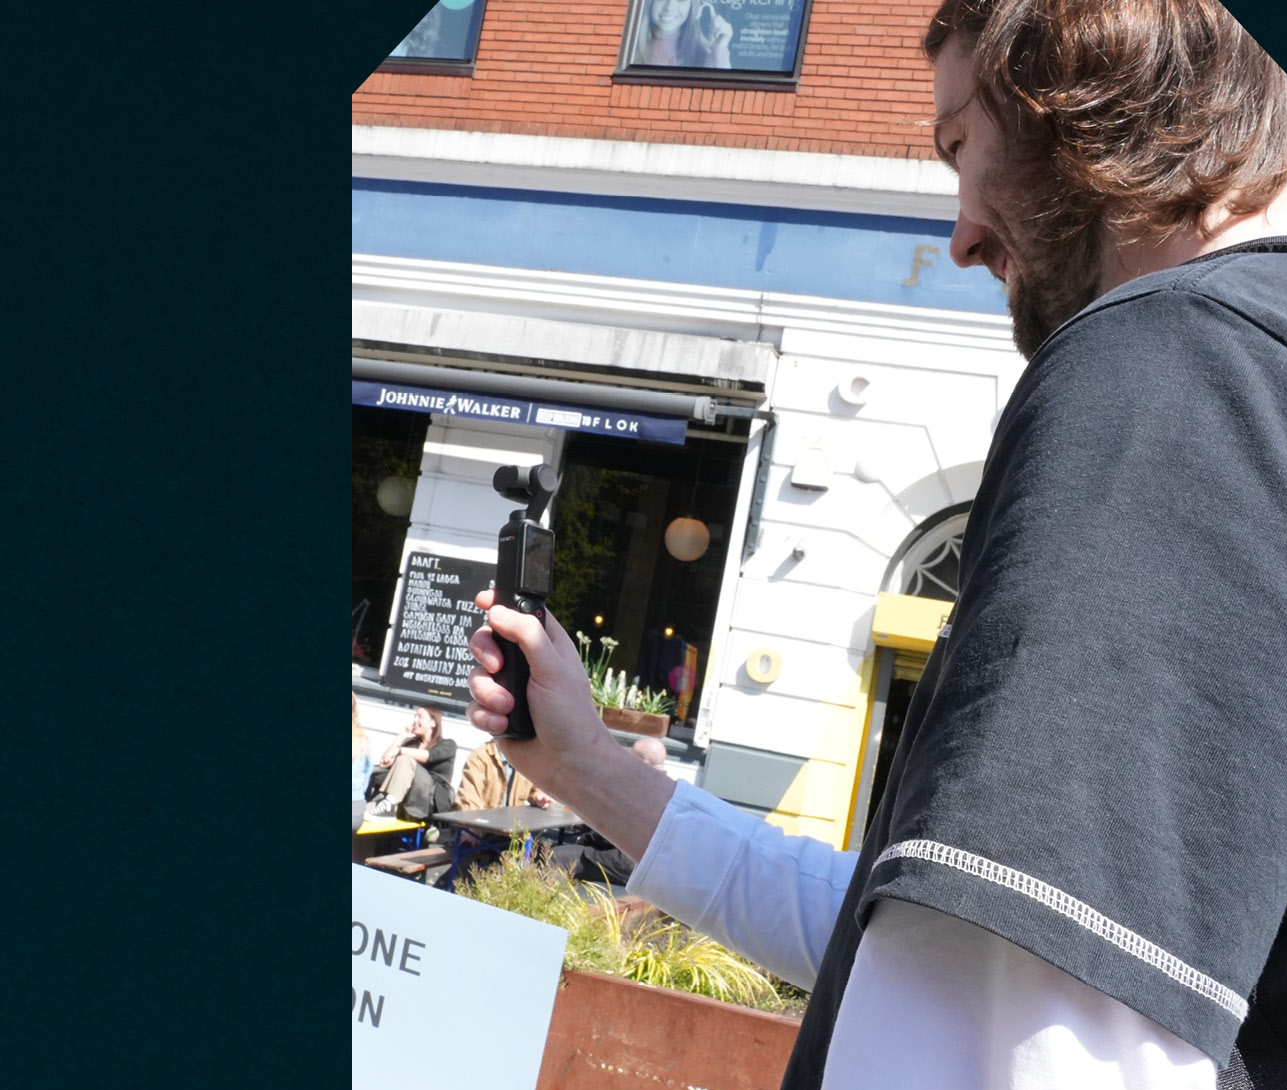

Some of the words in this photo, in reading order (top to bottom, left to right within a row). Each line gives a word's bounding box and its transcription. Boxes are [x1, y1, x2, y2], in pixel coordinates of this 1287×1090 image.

[376, 388, 444, 410] JOHNNIE
[457, 398, 521, 420] WALKER
[411, 555, 441, 570] DRAFT
[397, 641, 443, 657] ROTATING
[412, 658, 456, 675] INDUSTRY
[352, 920, 426, 977] ONE
